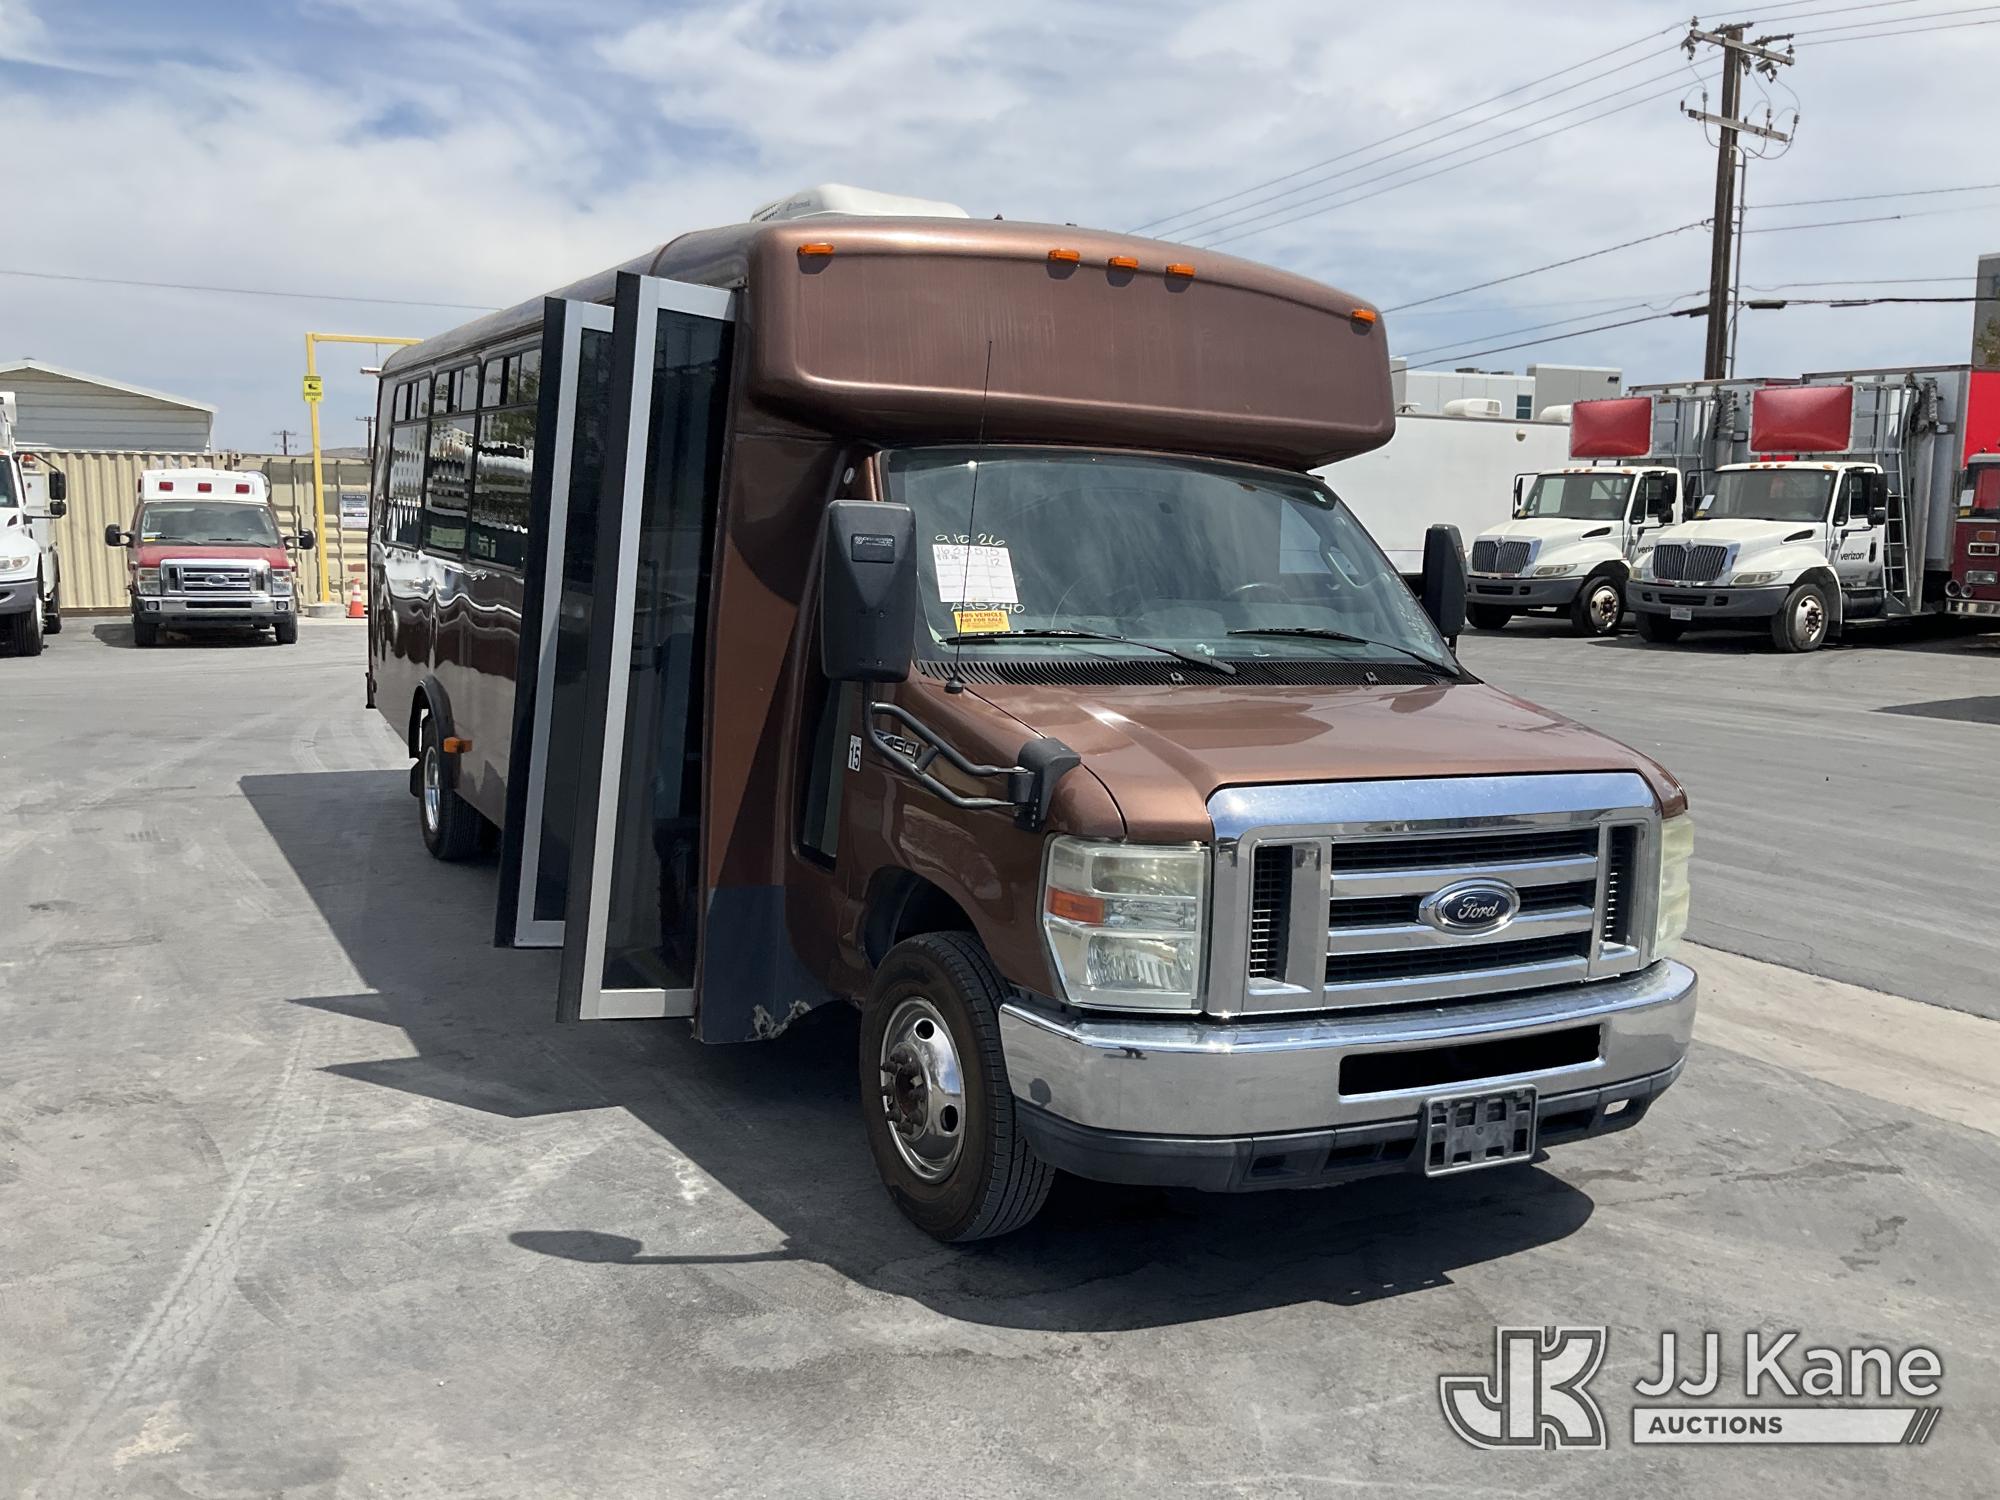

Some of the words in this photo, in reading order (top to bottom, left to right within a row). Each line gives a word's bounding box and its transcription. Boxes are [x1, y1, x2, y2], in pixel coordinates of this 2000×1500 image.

[1840, 551, 1865, 560] verizon
[850, 743, 860, 769] 15
[1457, 896, 1499, 919] Ford
